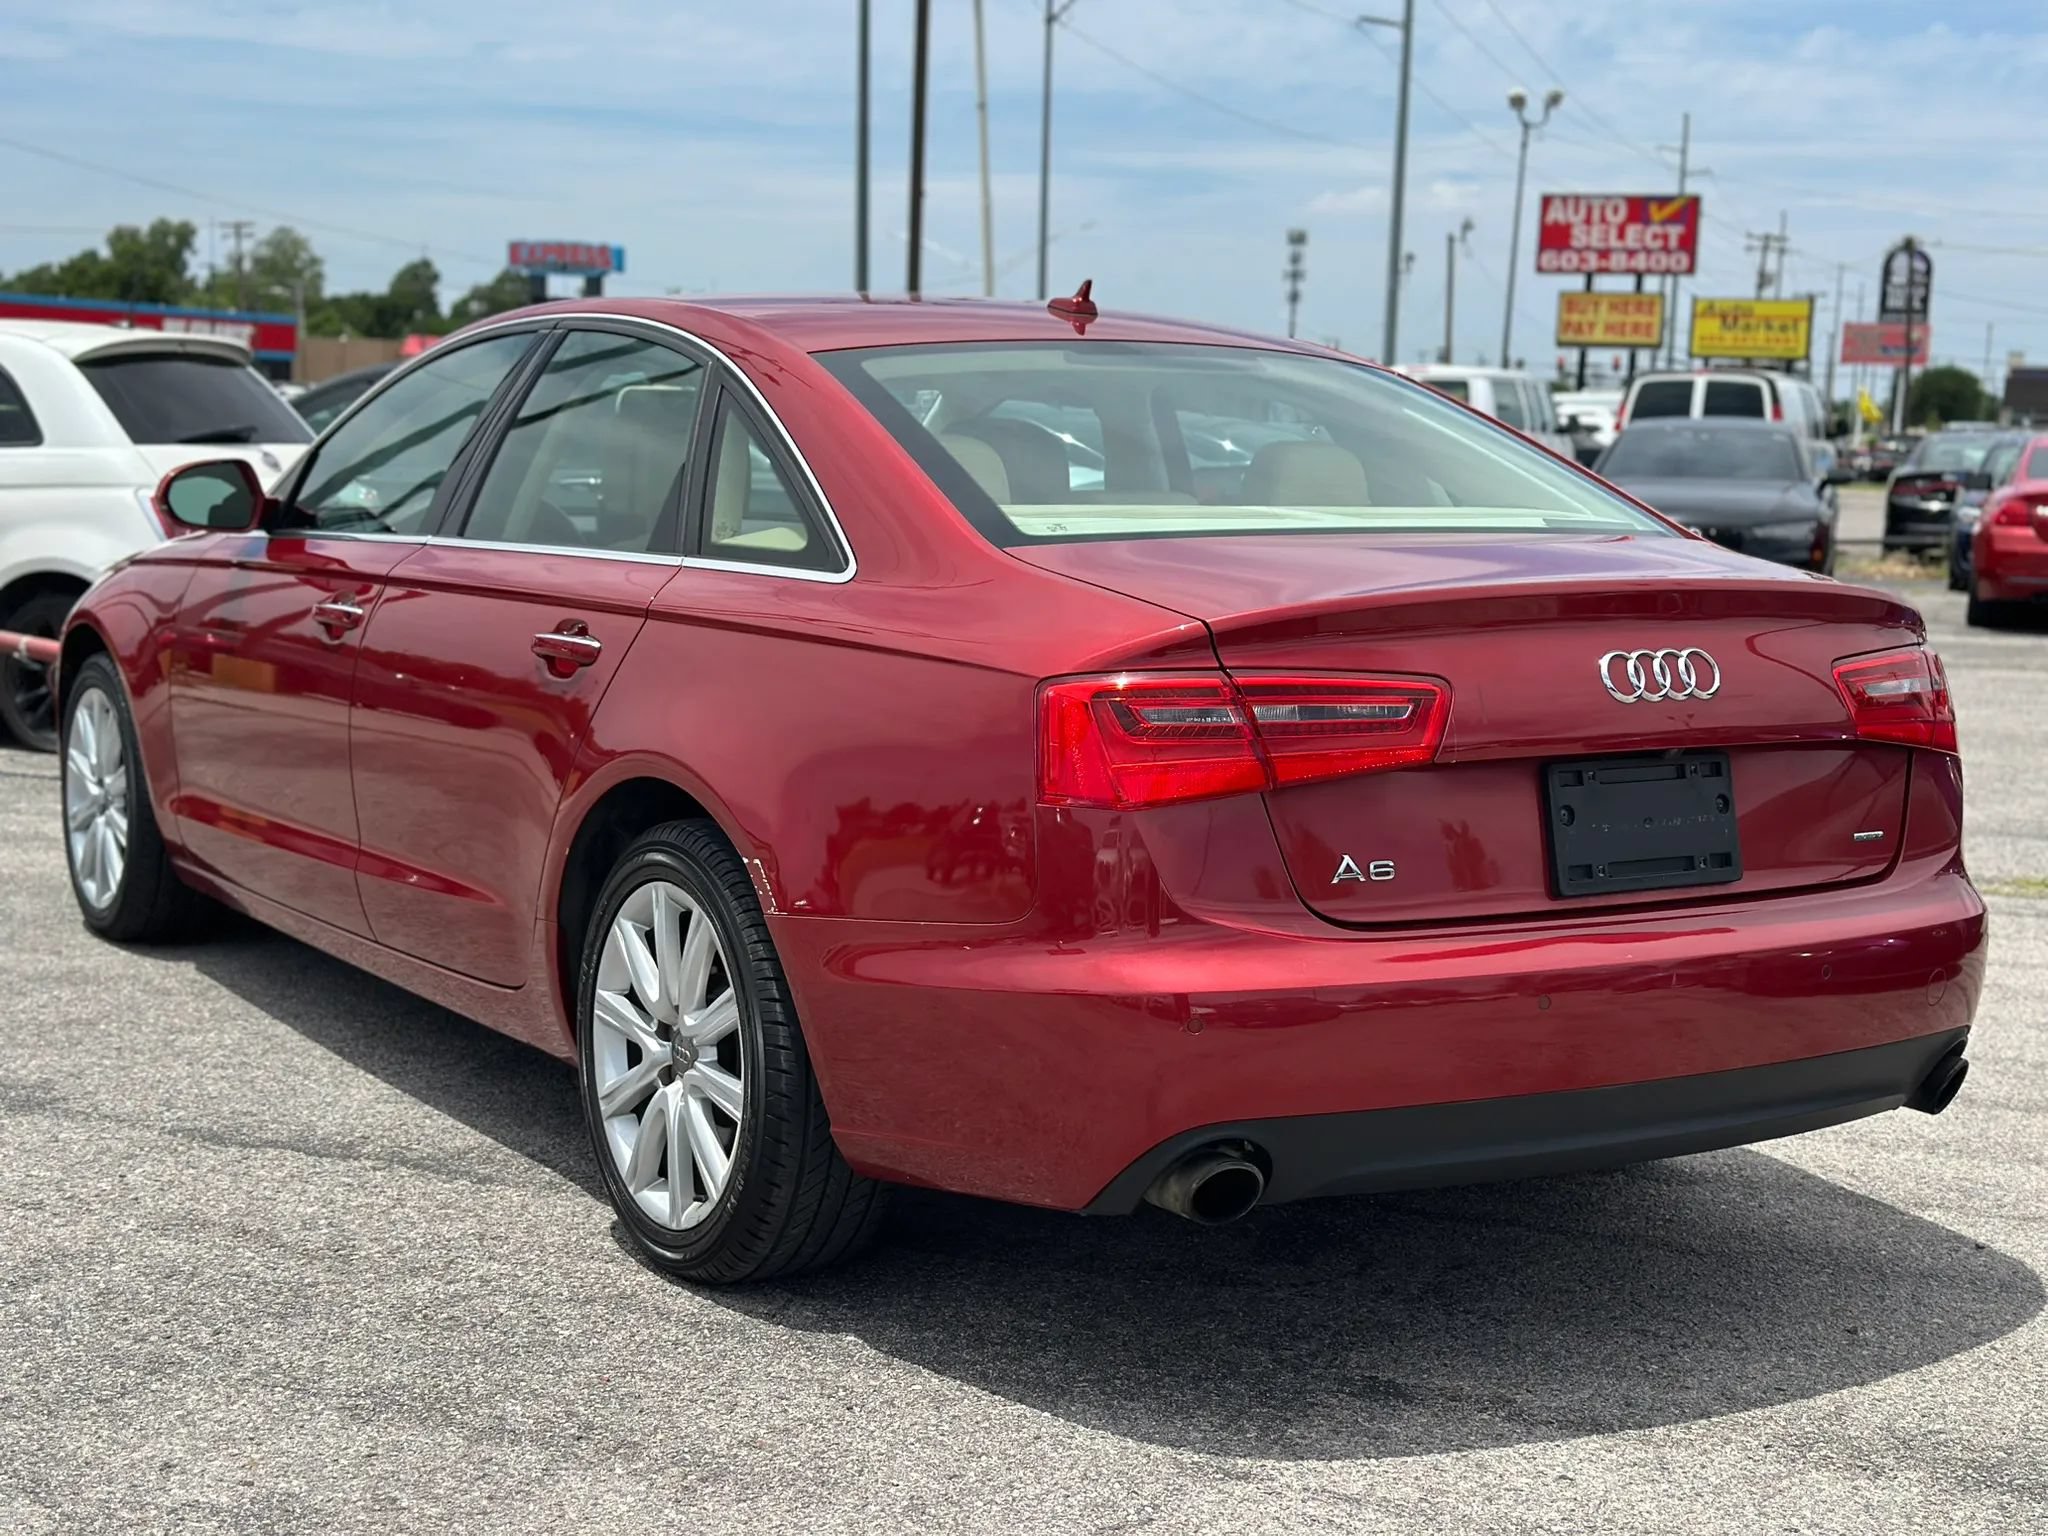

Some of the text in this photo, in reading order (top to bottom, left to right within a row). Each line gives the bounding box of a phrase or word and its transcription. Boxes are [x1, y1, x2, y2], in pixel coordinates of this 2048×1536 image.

[1544, 197, 1628, 225] AUTO
[1570, 223, 1686, 250] SELECT
[1540, 250, 1690, 273] 603-8400
[1565, 298, 1656, 317] BUY HERE
[1562, 320, 1654, 338] PAY HERE
[1720, 315, 1799, 333] Market
[1330, 854, 1396, 884] A6
